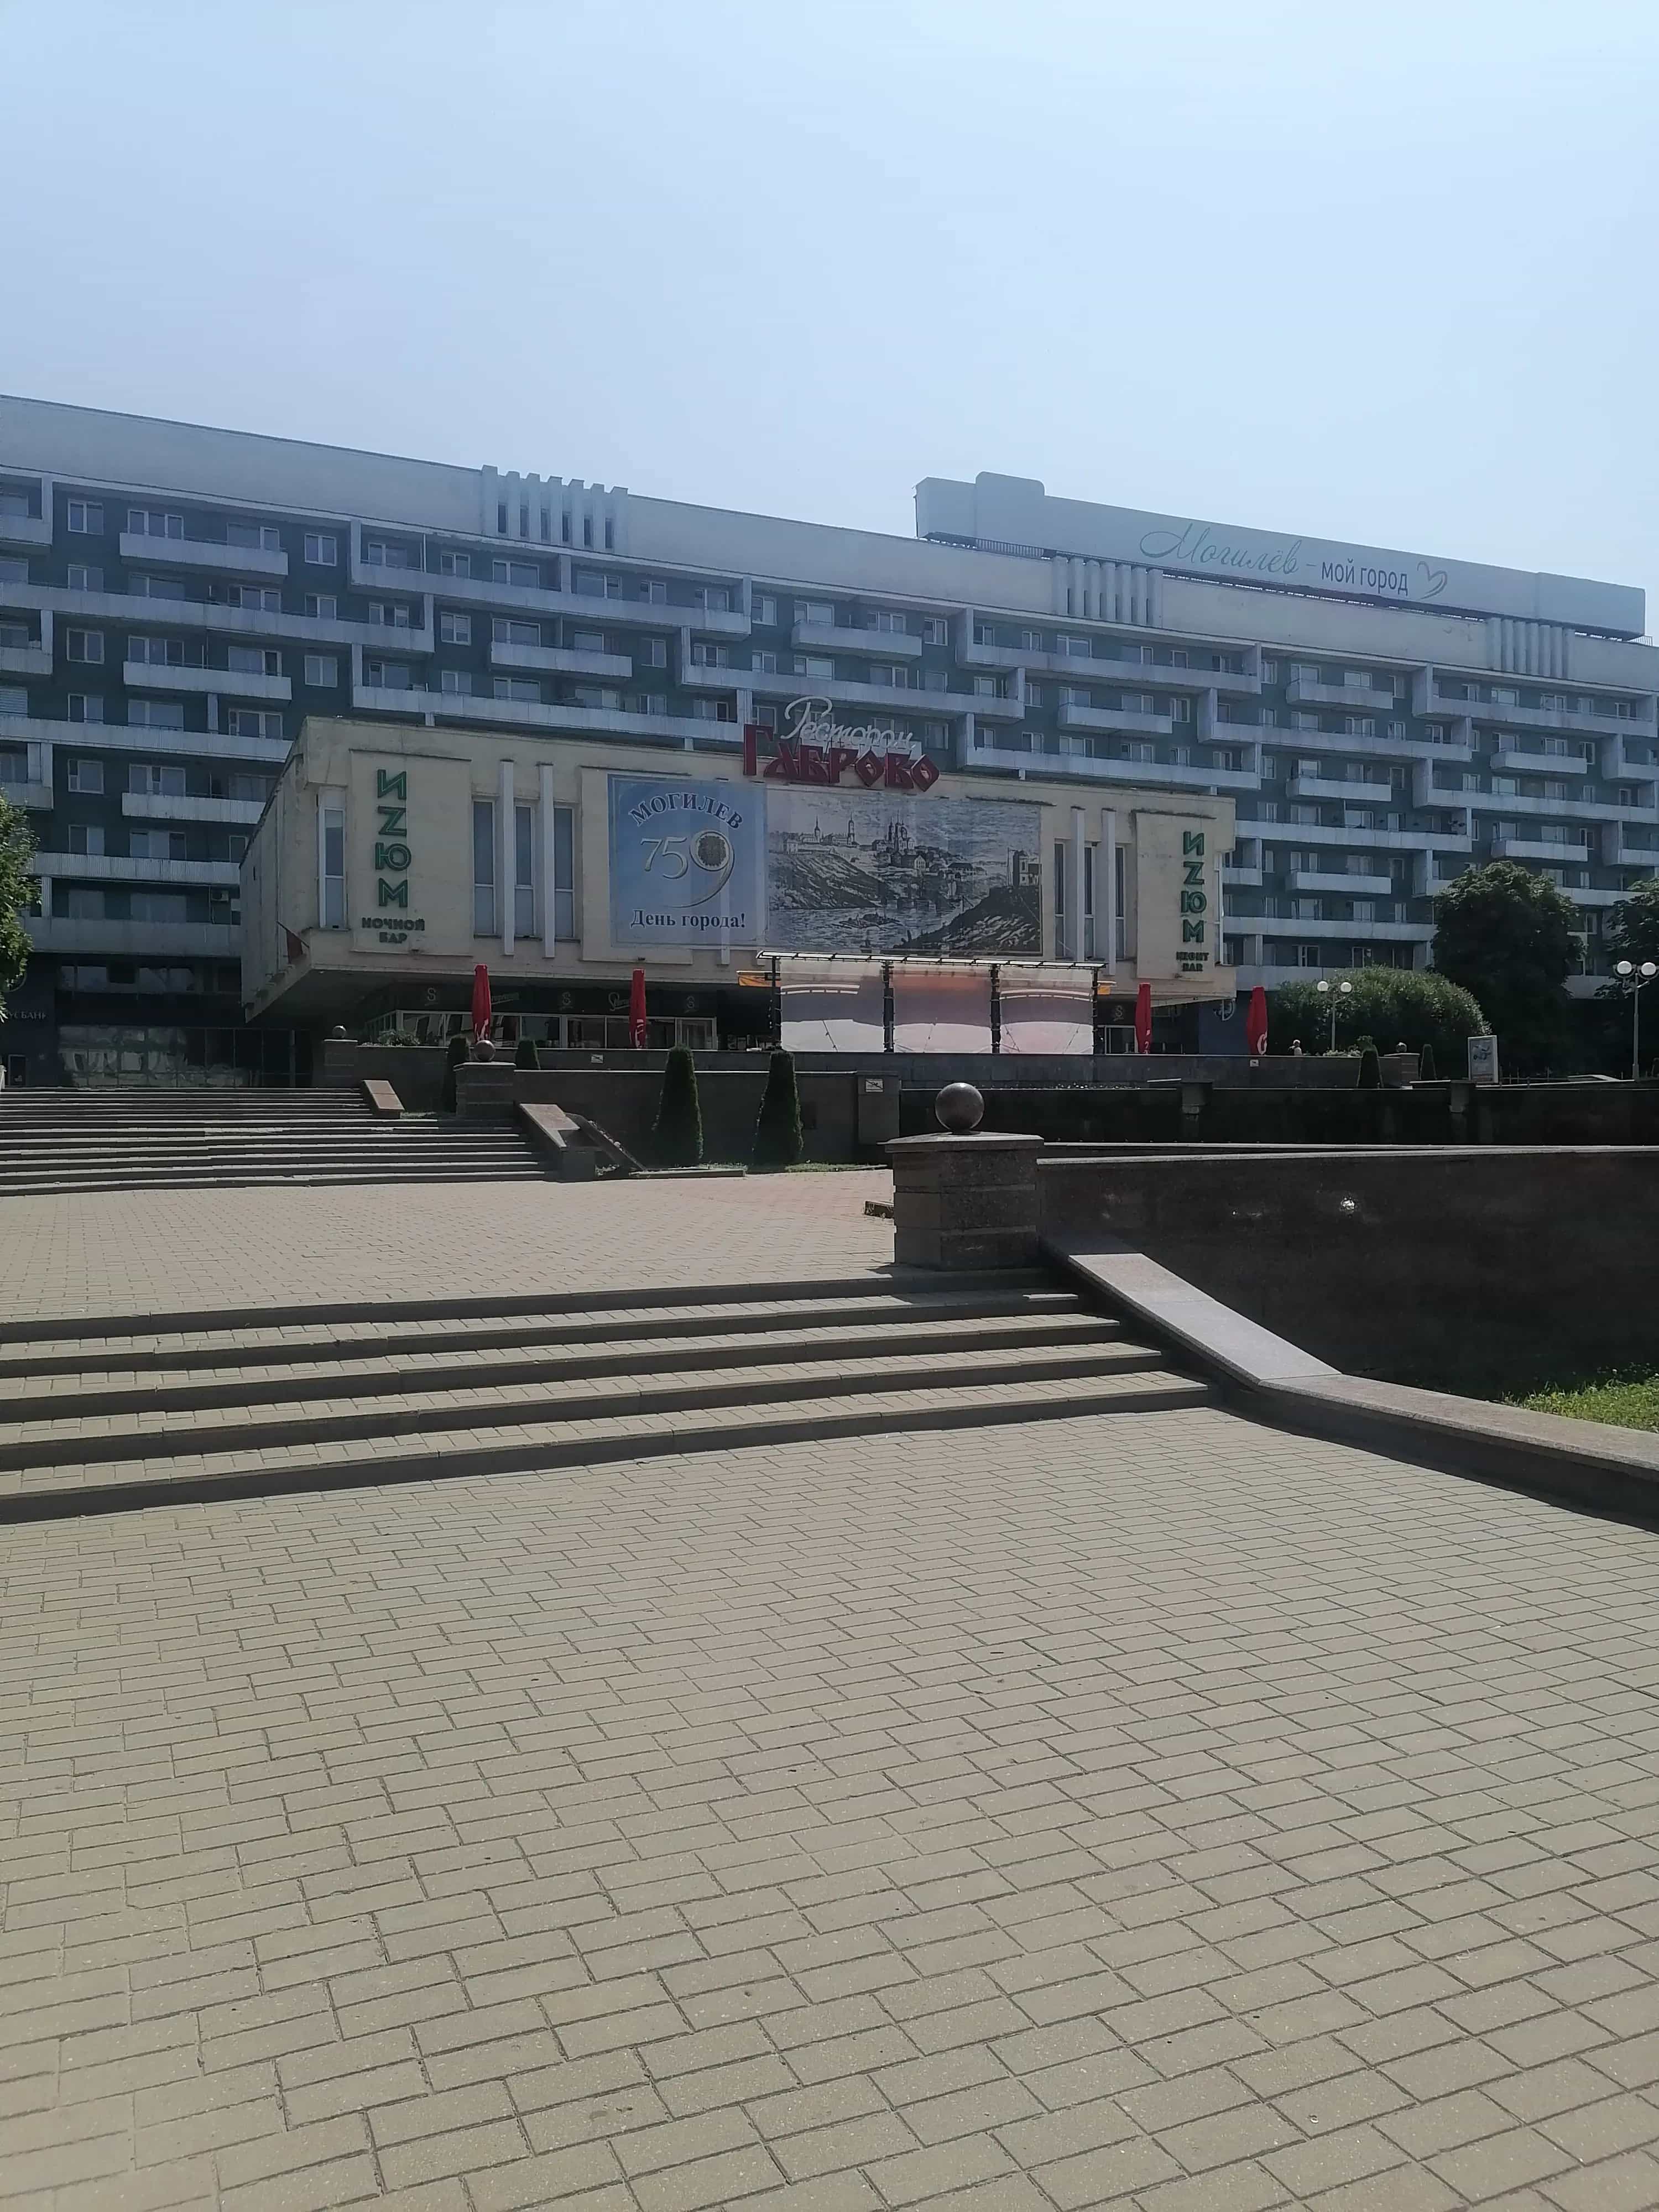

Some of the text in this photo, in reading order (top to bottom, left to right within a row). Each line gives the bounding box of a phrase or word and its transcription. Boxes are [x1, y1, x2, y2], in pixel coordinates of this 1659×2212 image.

[1140, 522, 1302, 575] Могилёв
[1321, 558, 1355, 585] мой
[1359, 566, 1408, 595] город
[780, 695, 917, 750] Ресторан
[743, 723, 940, 792] ГАБРОВО
[628, 792, 744, 830] МОГИЛЕВ
[361, 917, 425, 931] НОЧНОЙ
[630, 910, 746, 930] День города!
[379, 931, 408, 944] БАР
[1176, 951, 1209, 961] NIGHT
[1182, 962, 1203, 972] BAR
